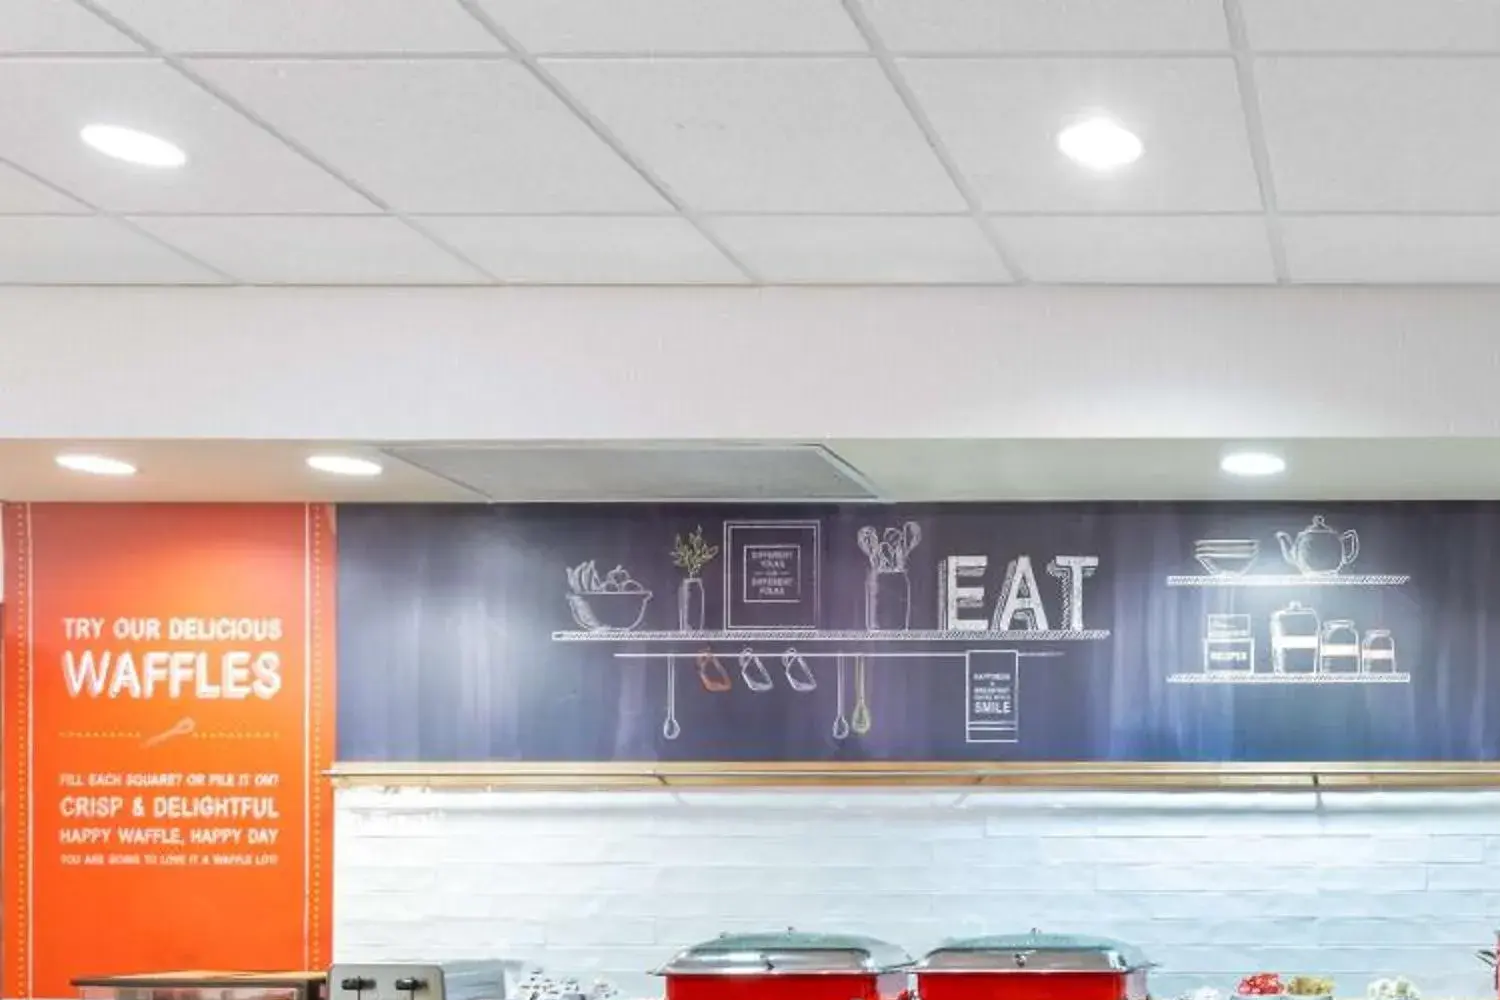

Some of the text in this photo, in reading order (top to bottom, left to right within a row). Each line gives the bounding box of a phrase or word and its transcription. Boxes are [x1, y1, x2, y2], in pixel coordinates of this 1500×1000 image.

[938, 555, 1099, 631] EAT
[64, 617, 283, 641] TRY OUR DELICIOUS
[61, 649, 282, 699] WAFFLES
[975, 701, 1012, 714] SMILE
[60, 796, 279, 818] CRISP & DELIGHTFUL
[59, 827, 111, 845] HAPPY
[190, 827, 241, 845] HAPPY
[248, 827, 279, 845] DAY
